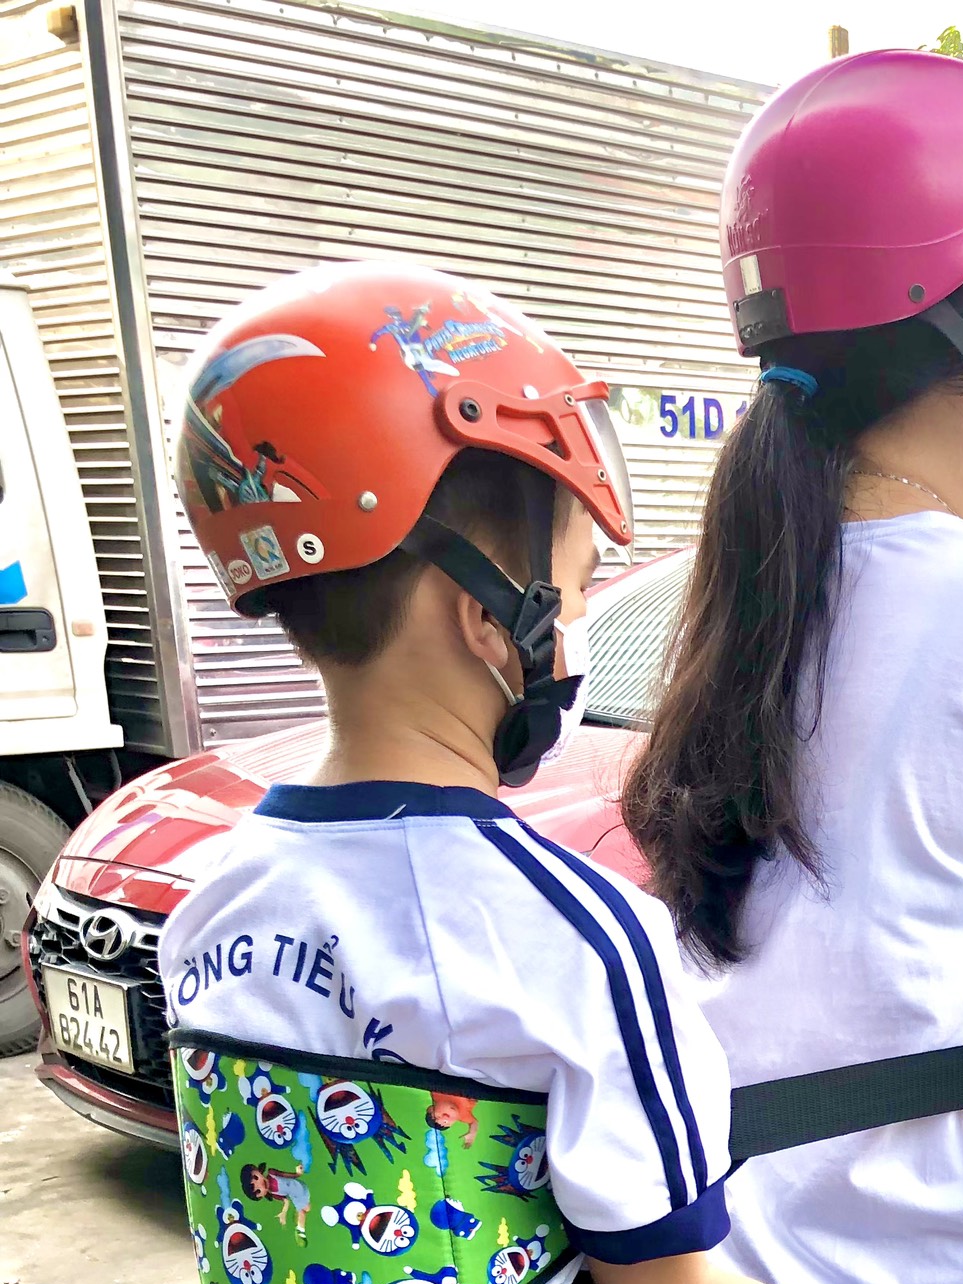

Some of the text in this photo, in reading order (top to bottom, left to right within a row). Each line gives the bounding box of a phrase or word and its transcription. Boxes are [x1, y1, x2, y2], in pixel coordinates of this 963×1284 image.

[660, 394, 724, 439] 51D
[303, 541, 317, 556] S
[67, 977, 104, 1020] 61A
[59, 1013, 122, 1064] 824.42
